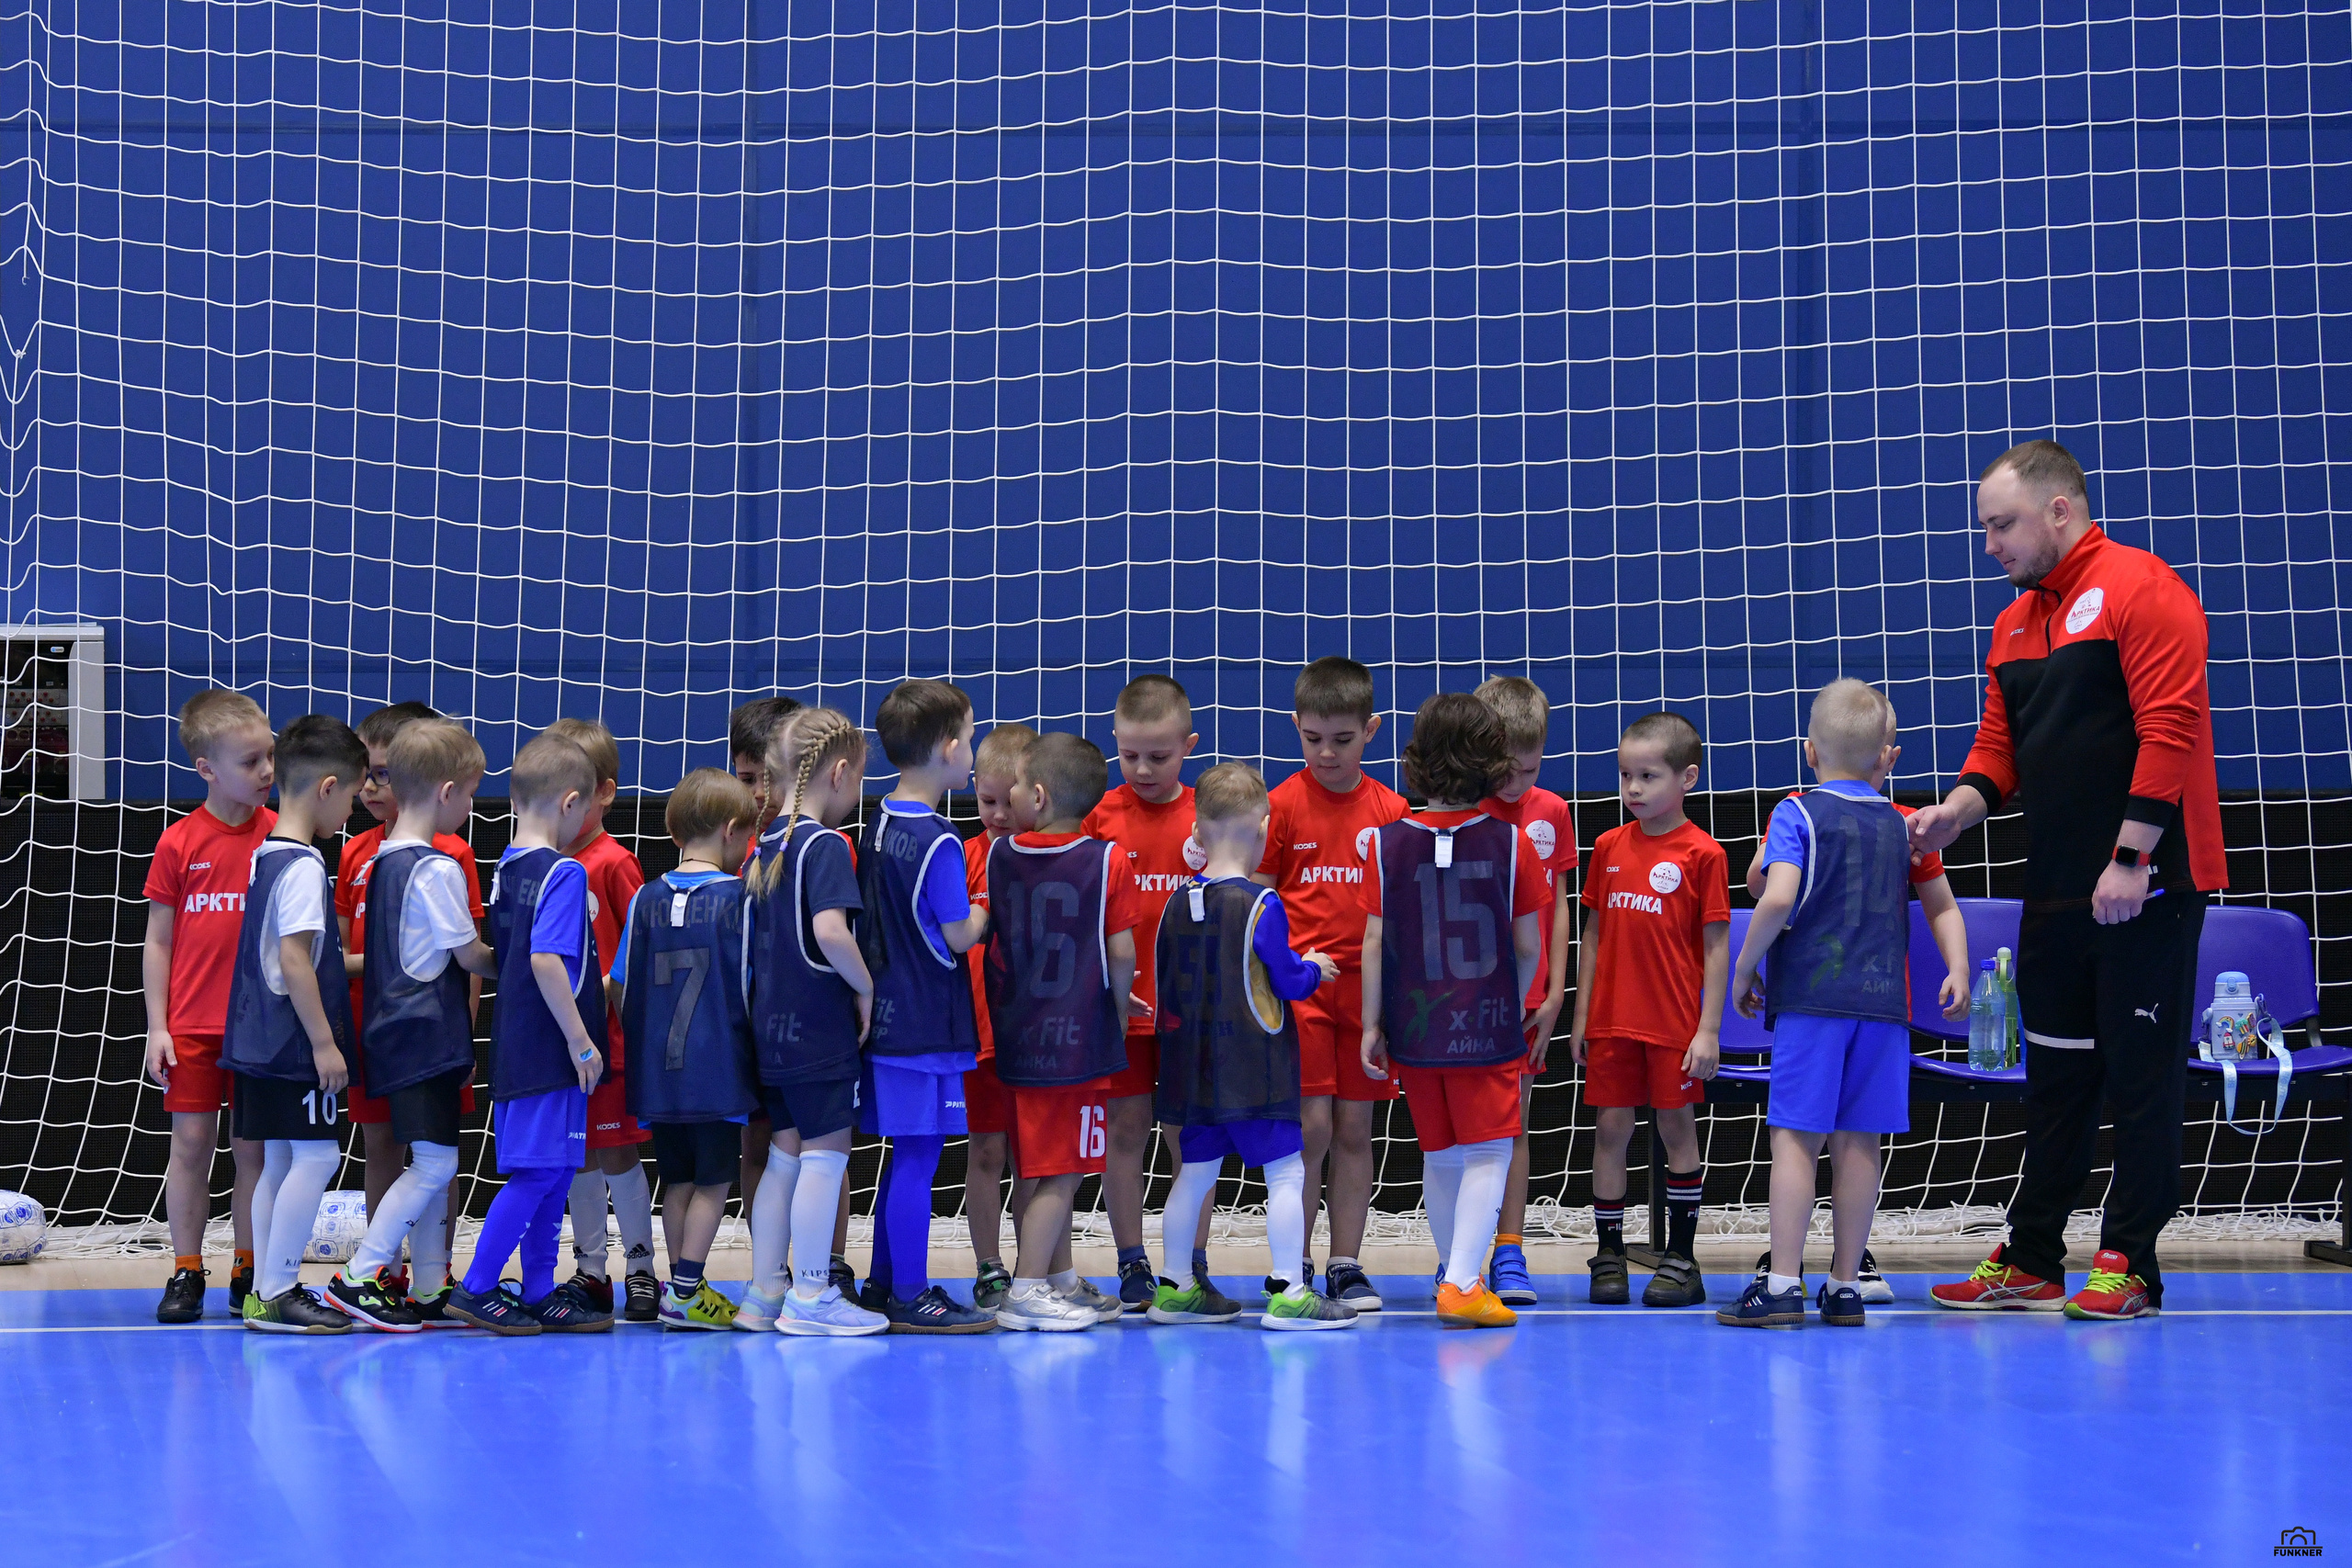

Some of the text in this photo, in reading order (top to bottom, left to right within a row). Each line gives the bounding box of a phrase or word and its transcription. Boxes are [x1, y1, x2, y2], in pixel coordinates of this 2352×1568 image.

[1293, 841, 1317, 851] KODES
[1005, 880, 1080, 999] 16
[1413, 861, 1497, 982] 15
[654, 947, 710, 1071] 7
[301, 1089, 337, 1125] 10
[596, 1122, 621, 1131] KODES
[1080, 1105, 1105, 1158] 16
[627, 1250, 650, 1259] adidas
